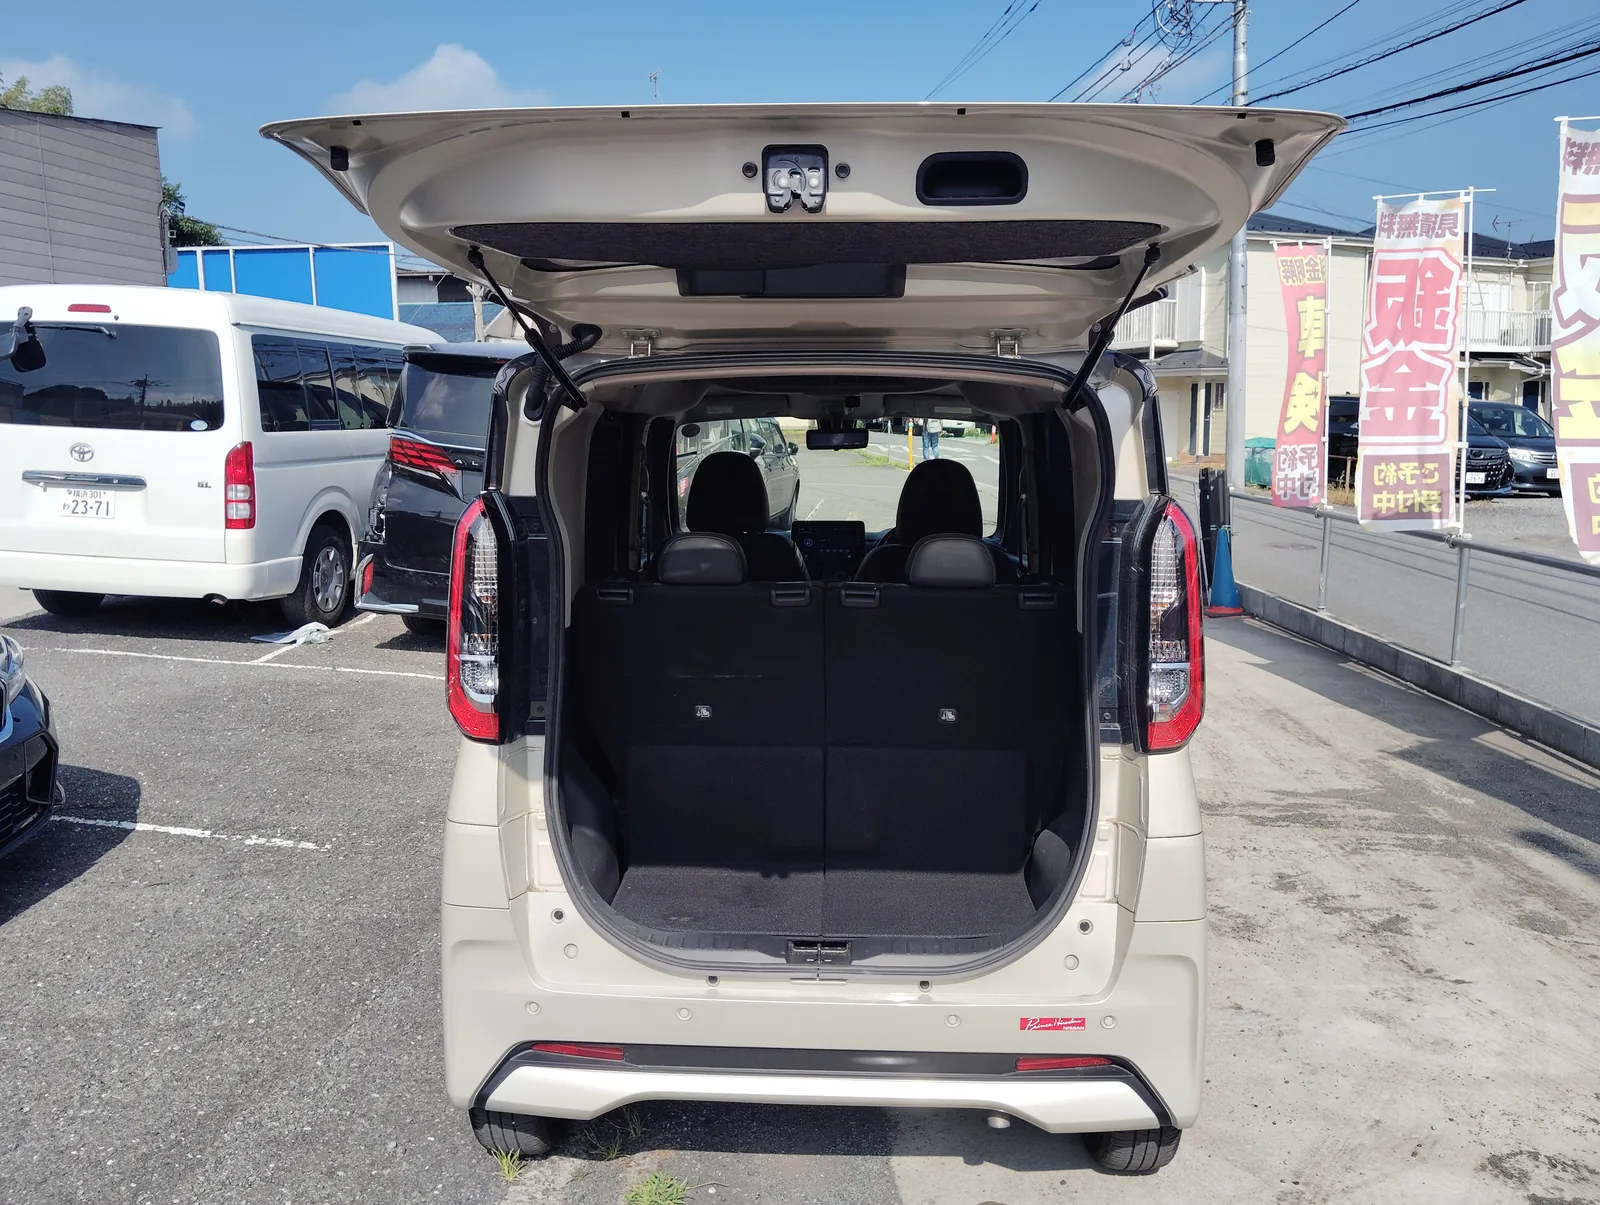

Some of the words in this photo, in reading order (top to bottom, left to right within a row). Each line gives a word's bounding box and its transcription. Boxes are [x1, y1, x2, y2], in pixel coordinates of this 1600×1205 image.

[62, 502, 70, 510] わ
[71, 499, 109, 516] 23-71
[1025, 1017, 1053, 1031] Prince
